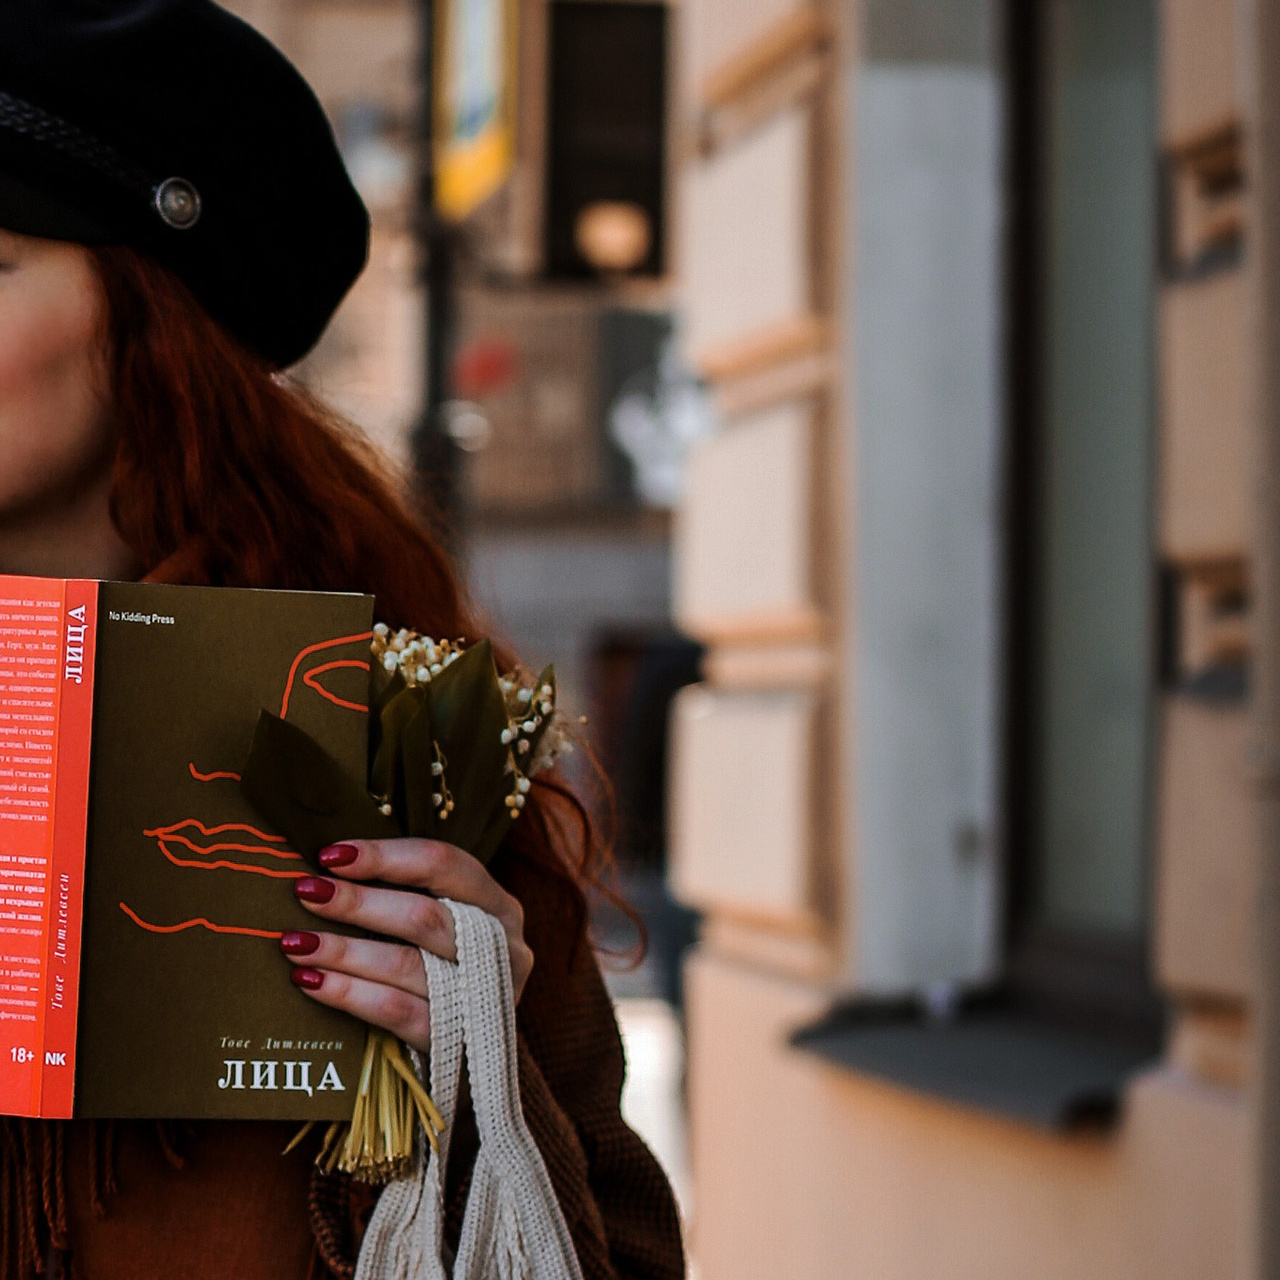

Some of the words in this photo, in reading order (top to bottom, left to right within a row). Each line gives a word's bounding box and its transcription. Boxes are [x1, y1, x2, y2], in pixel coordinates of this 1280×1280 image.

[109, 611, 120, 620] No
[121, 612, 151, 625] Kidding
[152, 614, 175, 624] Press
[65, 605, 89, 684] ЛИЦА
[51, 975, 65, 1010] Тове
[220, 1036, 251, 1049] Тове
[261, 1037, 343, 1050] Дитлевсен
[10, 1047, 35, 1063] 18+
[45, 1052, 66, 1066] NK
[217, 1060, 346, 1098] ЛИЦА
